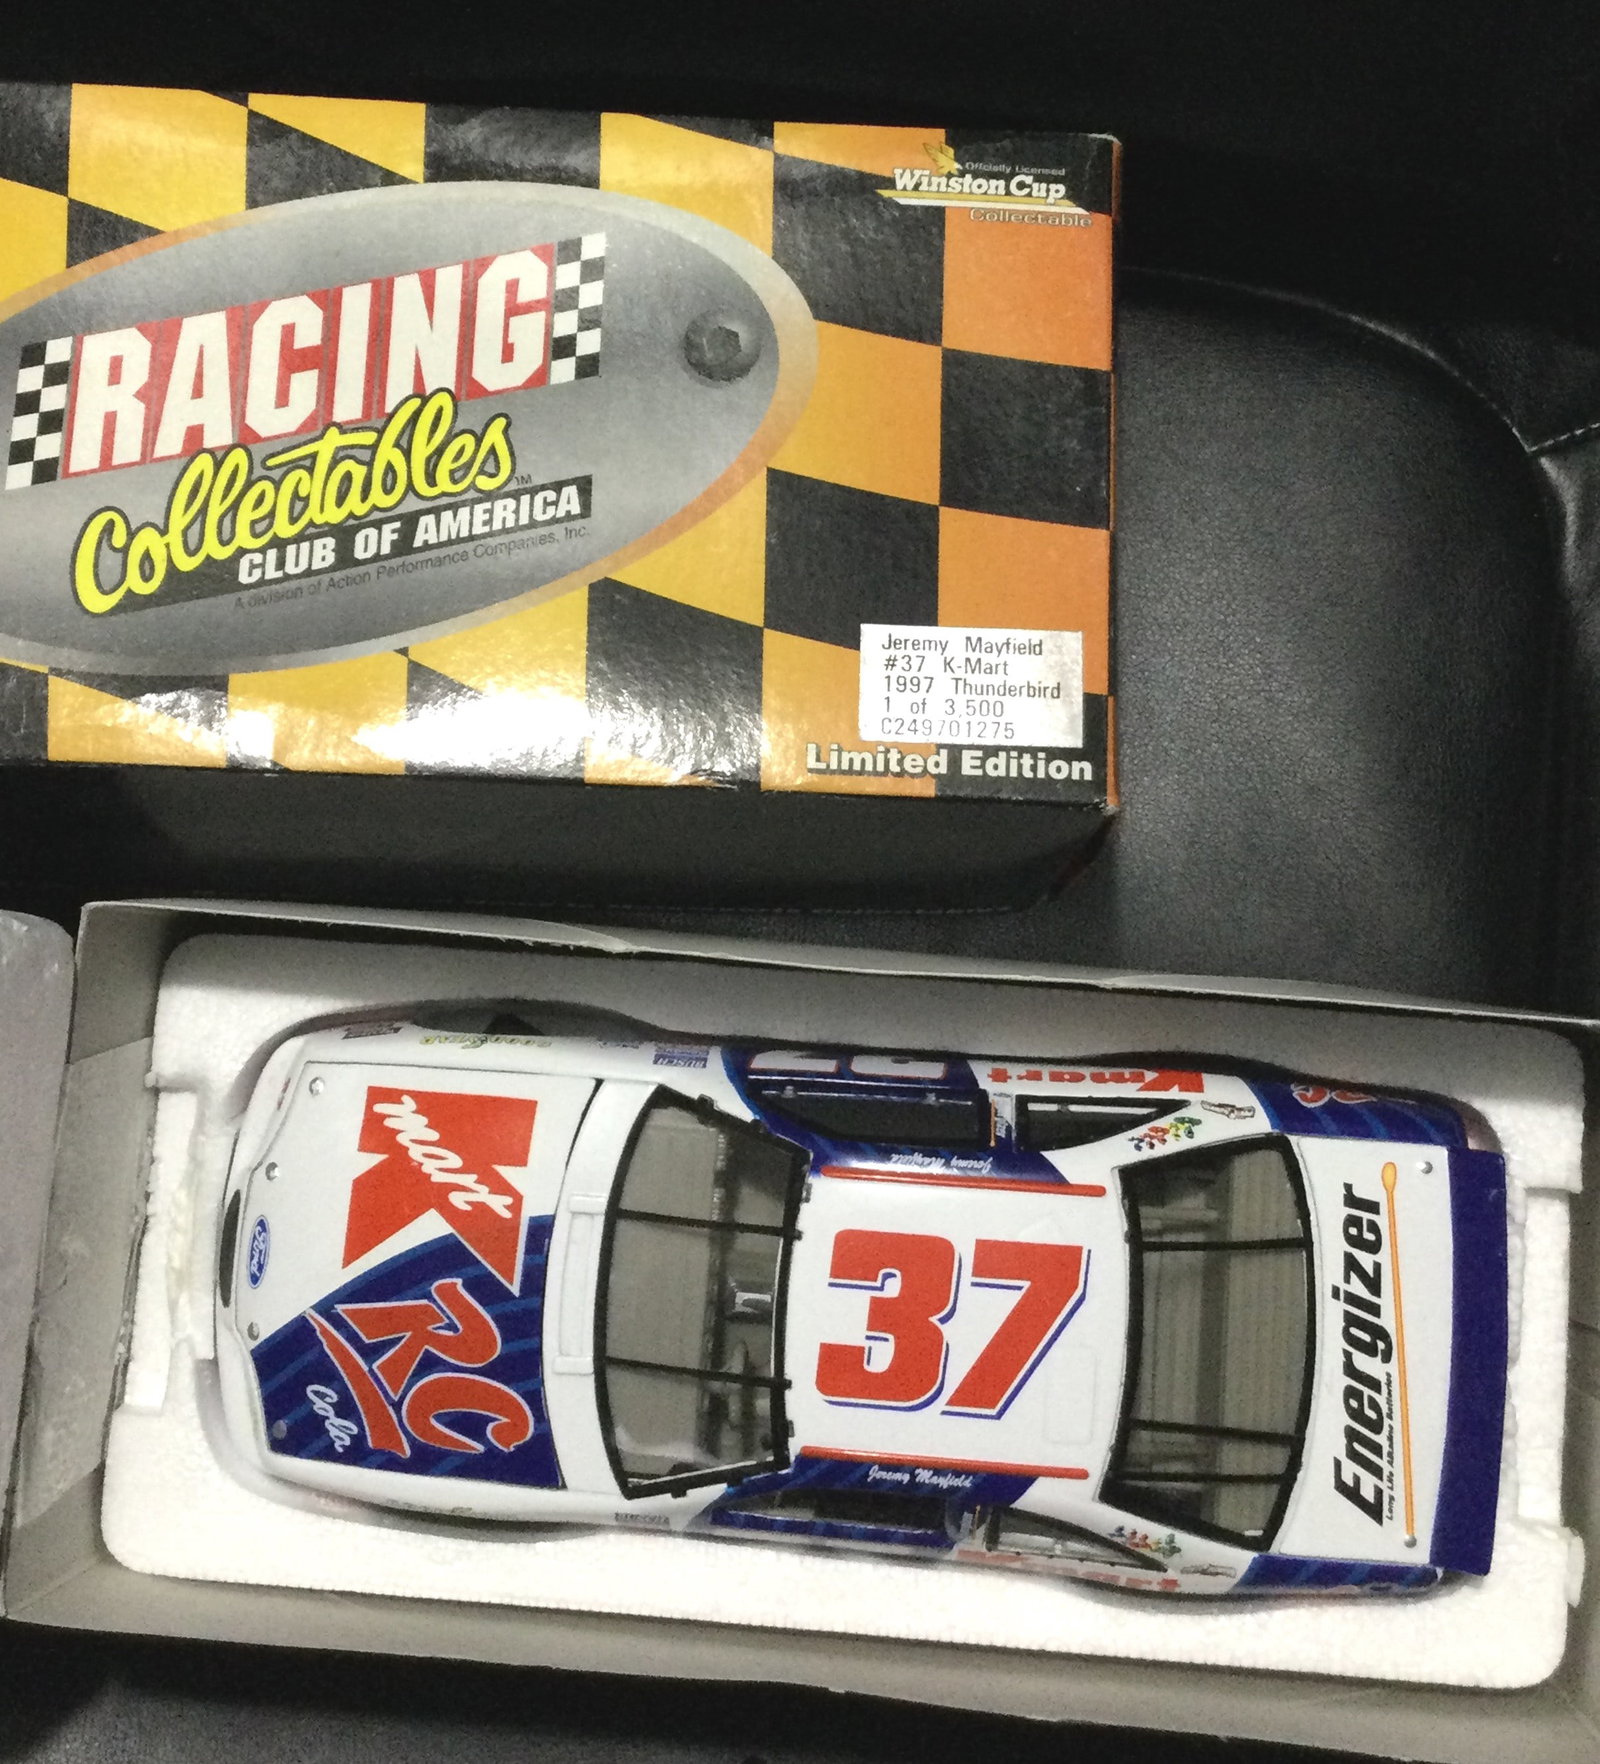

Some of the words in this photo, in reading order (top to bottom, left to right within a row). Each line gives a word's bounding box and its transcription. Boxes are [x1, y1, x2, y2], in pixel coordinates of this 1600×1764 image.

[893, 168, 1006, 196] Winston
[1009, 174, 1066, 204] Cup
[965, 161, 1012, 174] Officially
[1015, 165, 1066, 177] Licensed
[970, 207, 1093, 228] Collectable
[67, 249, 548, 475] RACING
[74, 390, 512, 613] Collectables
[238, 536, 336, 584] CLUB
[354, 521, 401, 560] OF
[412, 484, 581, 548] AMERICA
[233, 597, 245, 609] A
[249, 585, 303, 607] division
[307, 580, 323, 596] of
[326, 573, 371, 593] Action
[376, 550, 469, 580] Performance
[473, 533, 560, 557] Companies,
[565, 525, 590, 540] Inc.
[882, 633, 948, 655] Jeremy
[965, 636, 1043, 656] Mayfield
[884, 655, 926, 672] #37
[944, 657, 1009, 675] K-Mart
[884, 676, 934, 693] 1997
[951, 678, 1061, 699] Thunderbird
[884, 697, 891, 712] 1
[910, 699, 927, 714] of
[944, 699, 1004, 718] 3,500
[881, 718, 1015, 739] C249701275
[806, 743, 948, 777] Limited
[960, 750, 1092, 781] Edition
[251, 1223, 269, 1282] Ford
[816, 1228, 1091, 1420] 37
[320, 1278, 535, 1455] RC
[1332, 1183, 1394, 1527] Energizer
[306, 1384, 357, 1452] Cola
[867, 1464, 910, 1484] Jeremy
[915, 1467, 973, 1489] Mayfield
